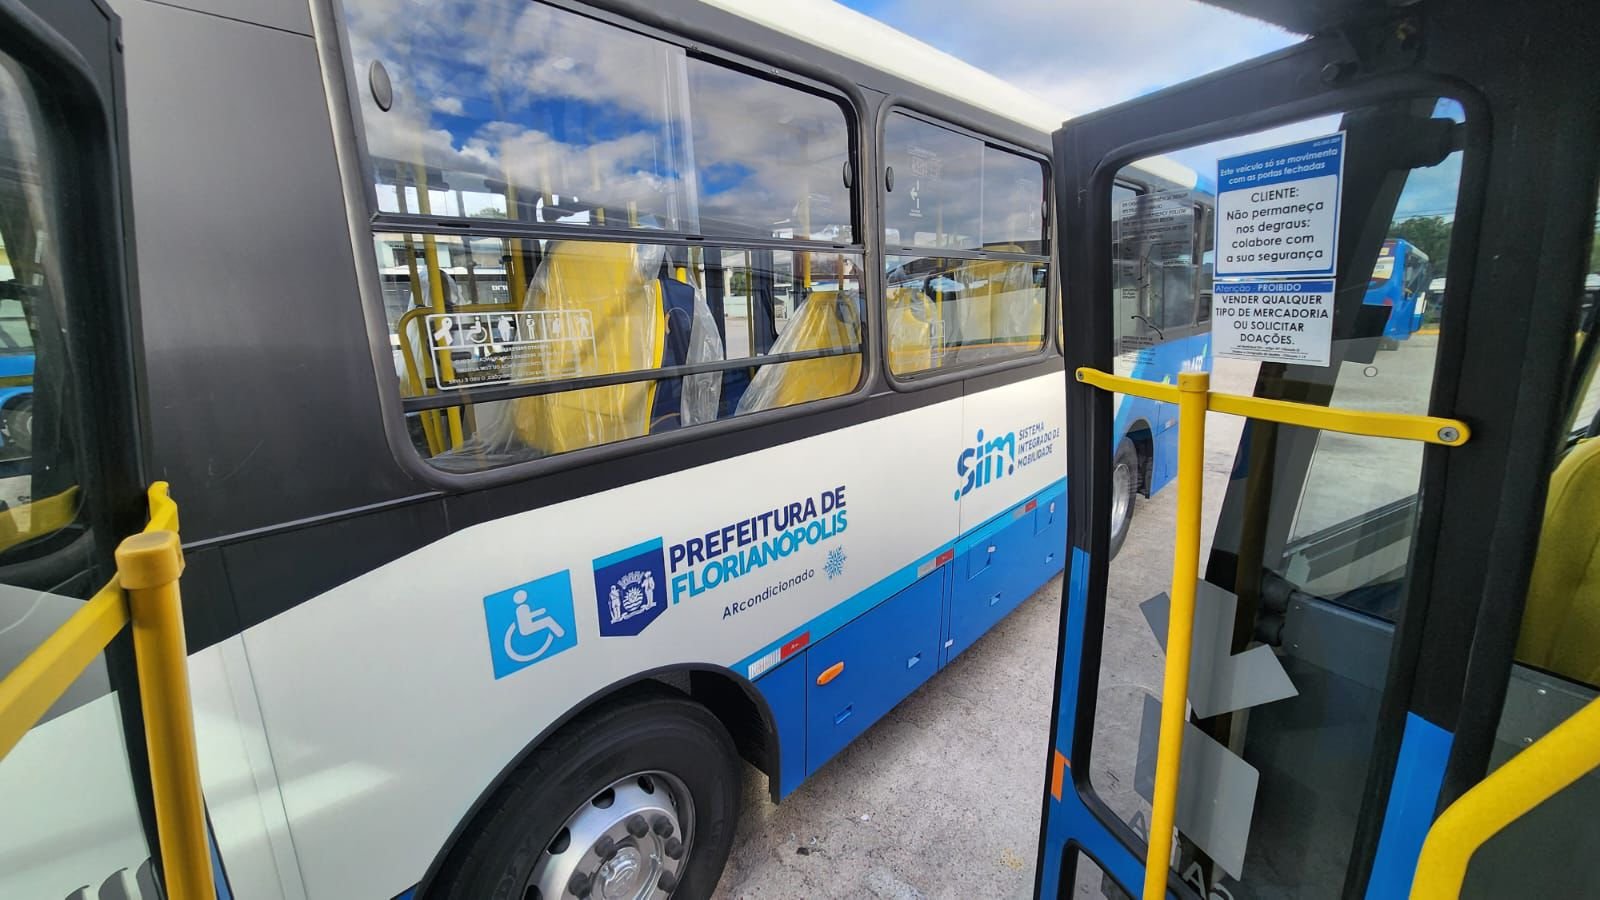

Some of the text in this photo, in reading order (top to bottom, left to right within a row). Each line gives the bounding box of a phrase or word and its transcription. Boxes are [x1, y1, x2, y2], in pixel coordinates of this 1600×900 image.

[1220, 148, 1338, 177] Este veículo só se movimenta
[1229, 162, 1326, 185] com as portas fechadas
[1251, 187, 1299, 203] CLIENTE:
[1226, 200, 1324, 222] Não permaneça
[1236, 217, 1311, 234] nos degraus:
[1231, 234, 1315, 249] colabore com
[1226, 248, 1323, 263] a sua segurança
[1215, 283, 1251, 293] Atenção
[1257, 283, 1301, 292] PROIBIDO
[1222, 294, 1322, 305] VENDER QUALQUER
[1215, 307, 1329, 319] TIPO DE MERCADORIA
[1233, 320, 1304, 332] OU SOLICITAR
[1240, 332, 1295, 345] DOAÇÕES.
[1019, 421, 1044, 440] SISTEMA
[1018, 427, 1060, 454] INTEGRADO DE
[1017, 443, 1053, 468] MOBILIDADE
[669, 485, 846, 574] PREFEITURA DE
[671, 509, 848, 605] FLORIANÓPOLIS
[722, 568, 815, 620] ARcondicionado
